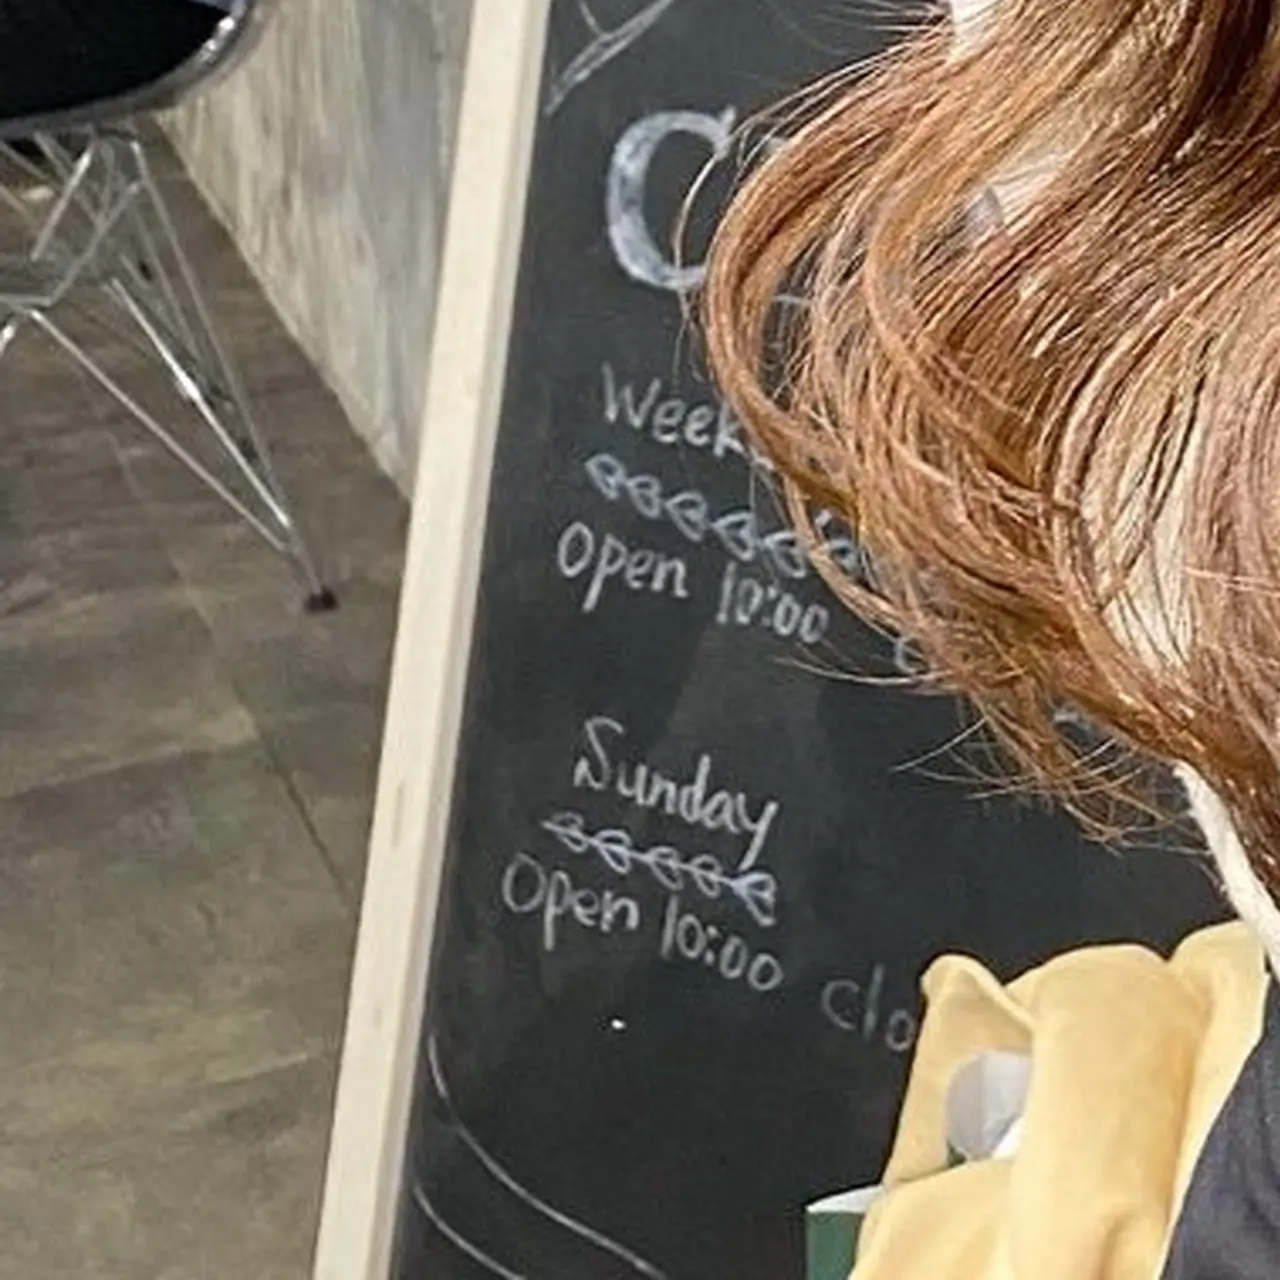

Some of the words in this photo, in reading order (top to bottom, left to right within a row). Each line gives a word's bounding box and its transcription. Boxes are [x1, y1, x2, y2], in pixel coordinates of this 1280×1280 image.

[602, 361, 775, 471] Week
[556, 520, 690, 614] Open
[715, 559, 830, 644] 10:00
[572, 716, 779, 872] Sunday
[502, 852, 641, 952] Open
[658, 894, 786, 992] 10:00
